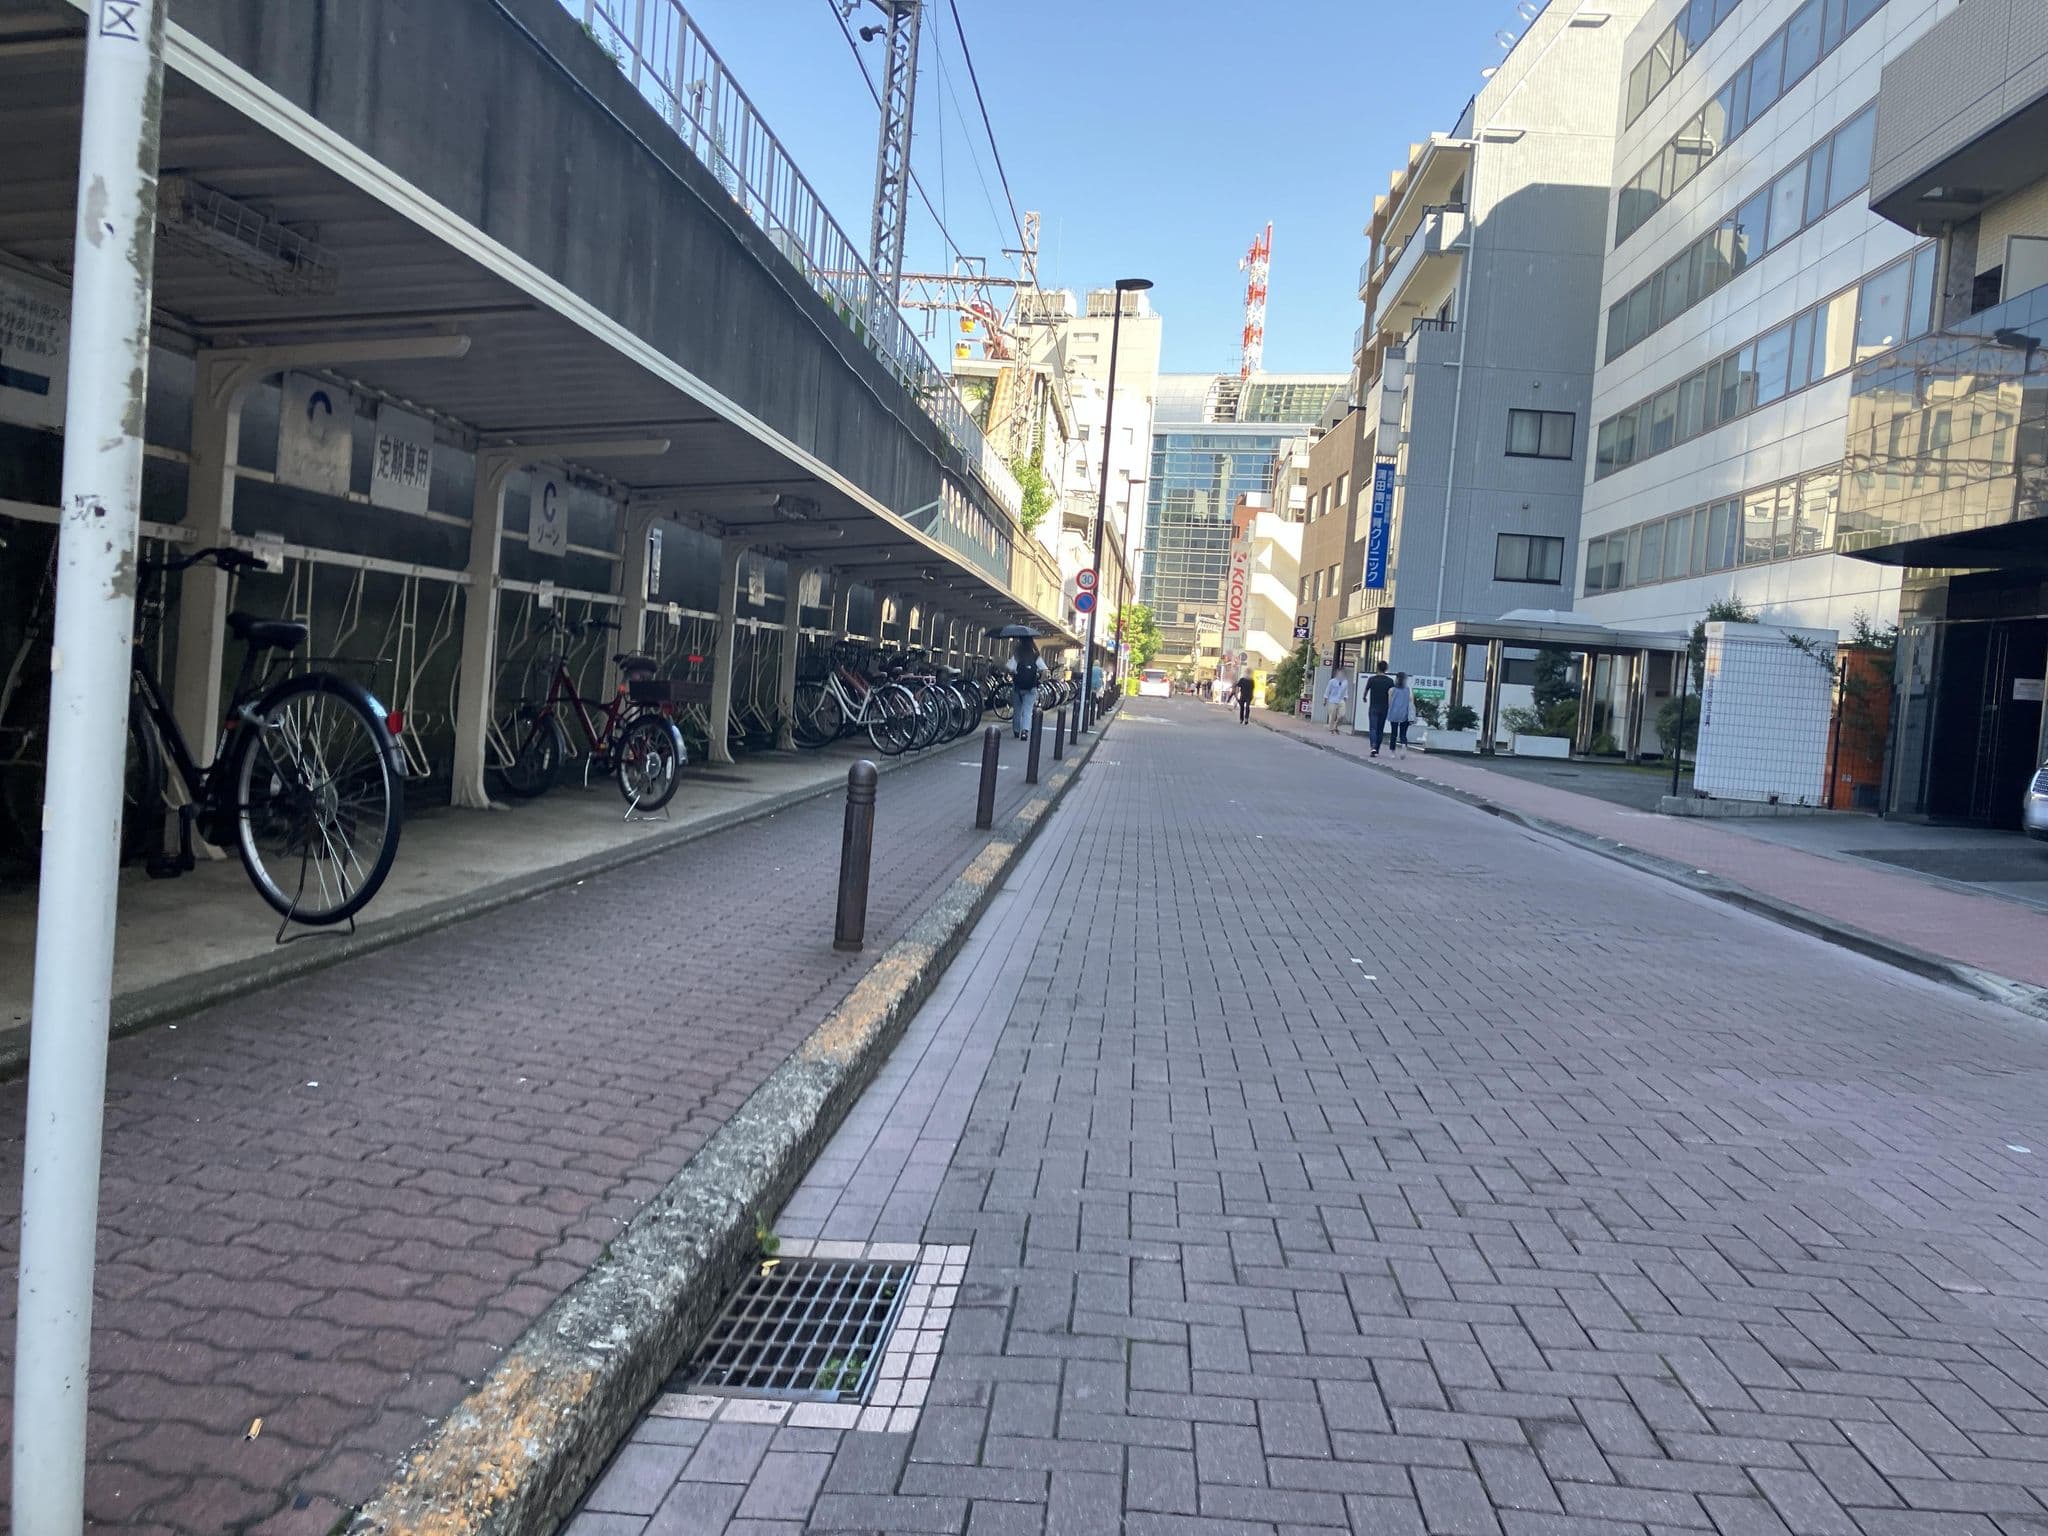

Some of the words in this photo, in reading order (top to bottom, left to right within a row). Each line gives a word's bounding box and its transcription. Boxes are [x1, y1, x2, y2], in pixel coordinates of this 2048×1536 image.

[100, 0, 142, 41] 区
[376, 434, 429, 489] 定期専用
[543, 481, 557, 522] C
[1081, 574, 1094, 585] 30
[1228, 567, 1245, 632] KICONA
